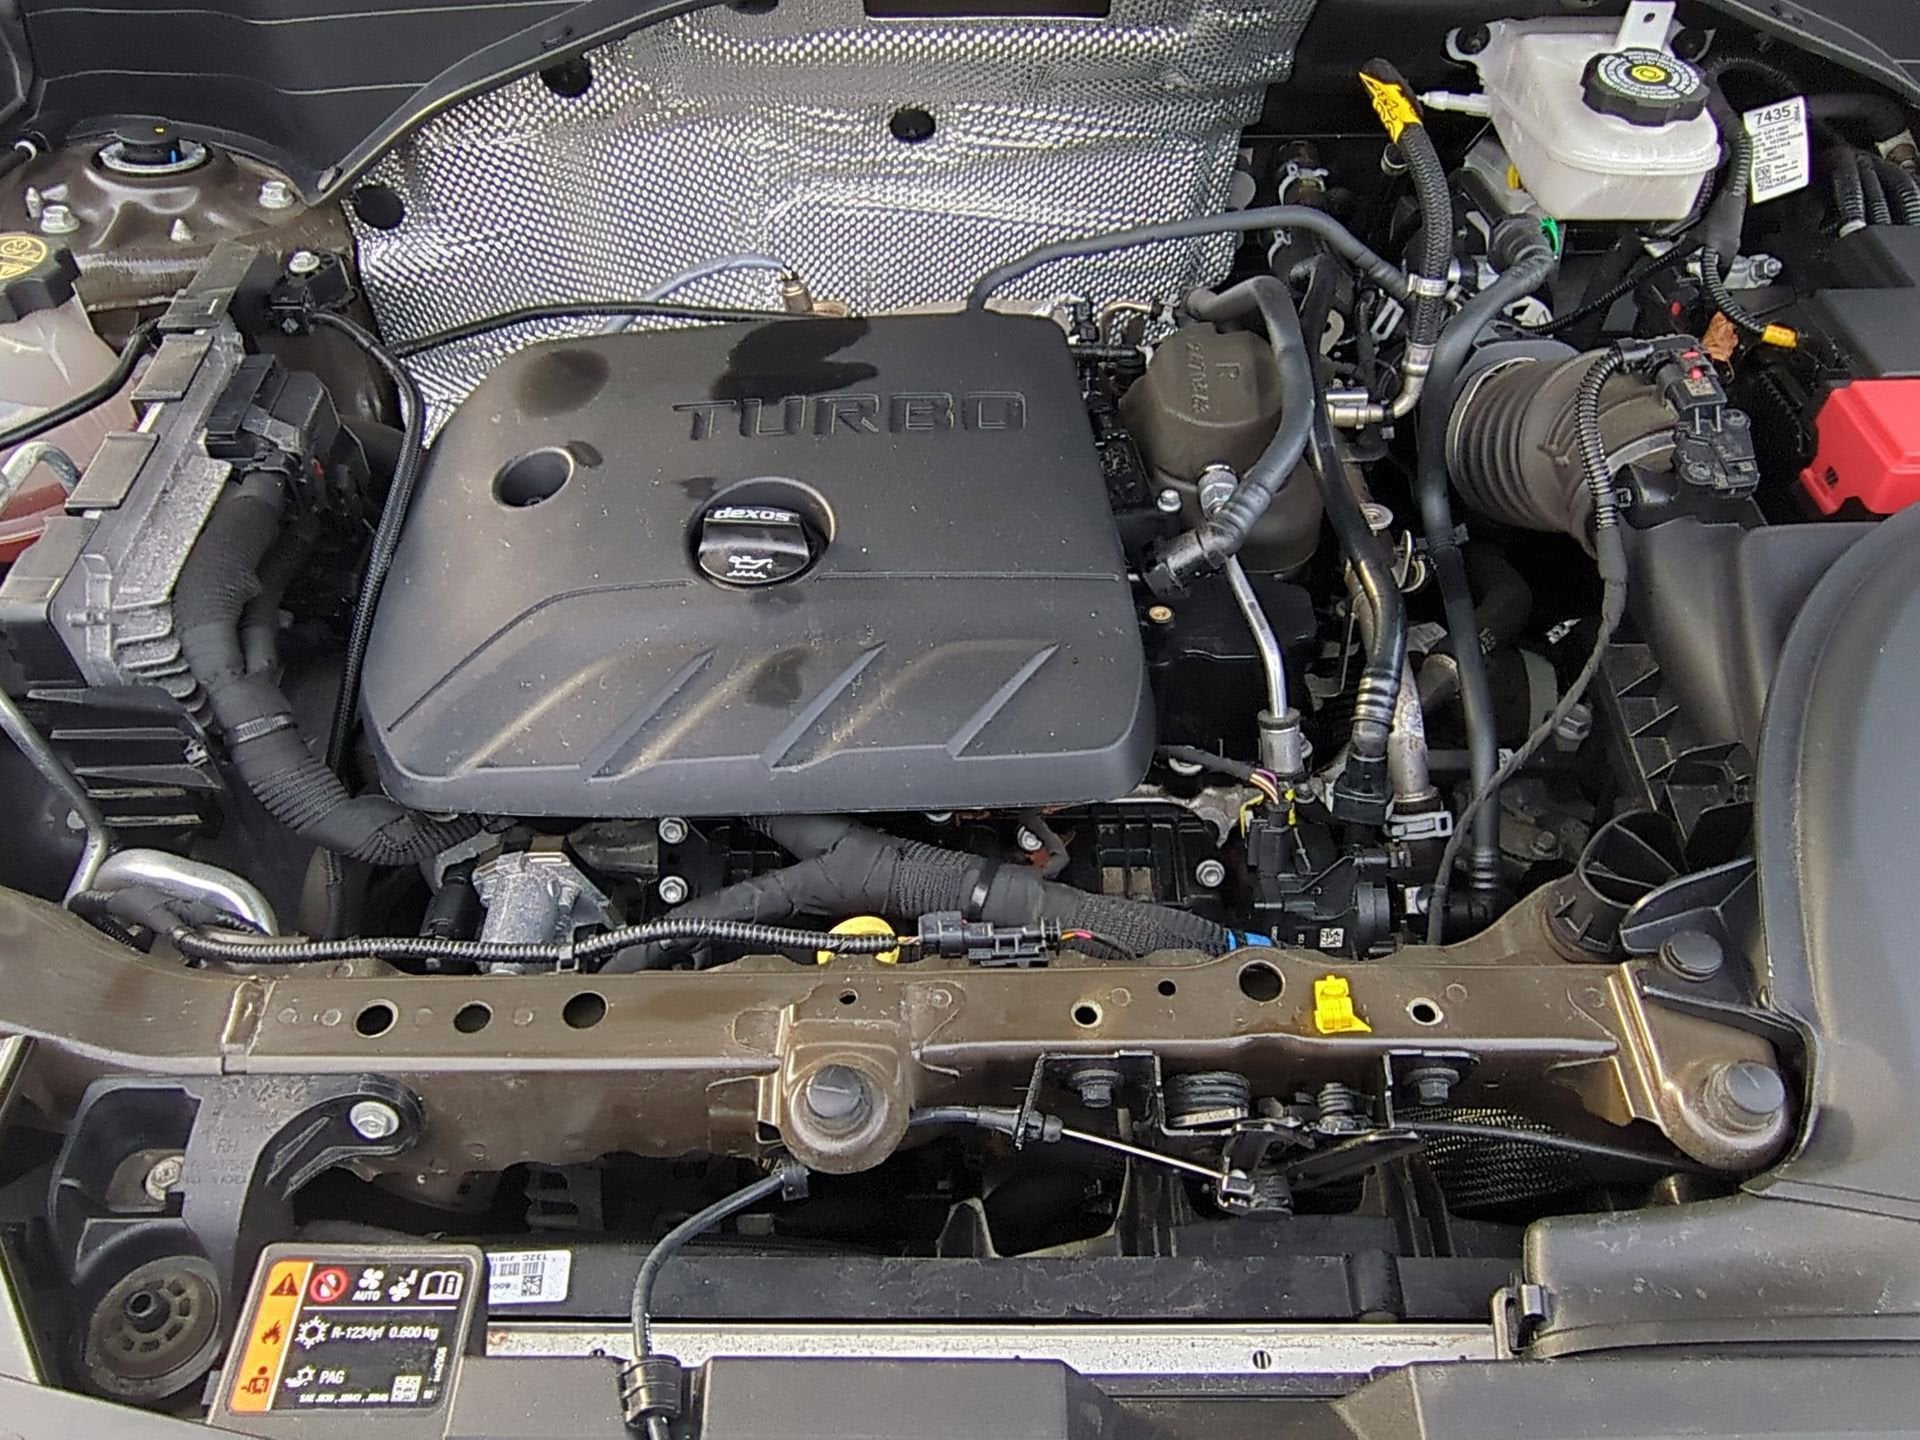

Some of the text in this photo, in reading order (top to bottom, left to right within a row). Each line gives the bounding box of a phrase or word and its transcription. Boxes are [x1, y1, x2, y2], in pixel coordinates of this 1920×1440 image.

[1754, 105, 1791, 125] 7435
[673, 391, 1027, 440] TURBO
[713, 506, 791, 522] dexos
[351, 1290, 381, 1301] AUTO
[330, 1325, 440, 1341] R-1234yf 0.600 kg
[318, 1370, 345, 1385] PAG
